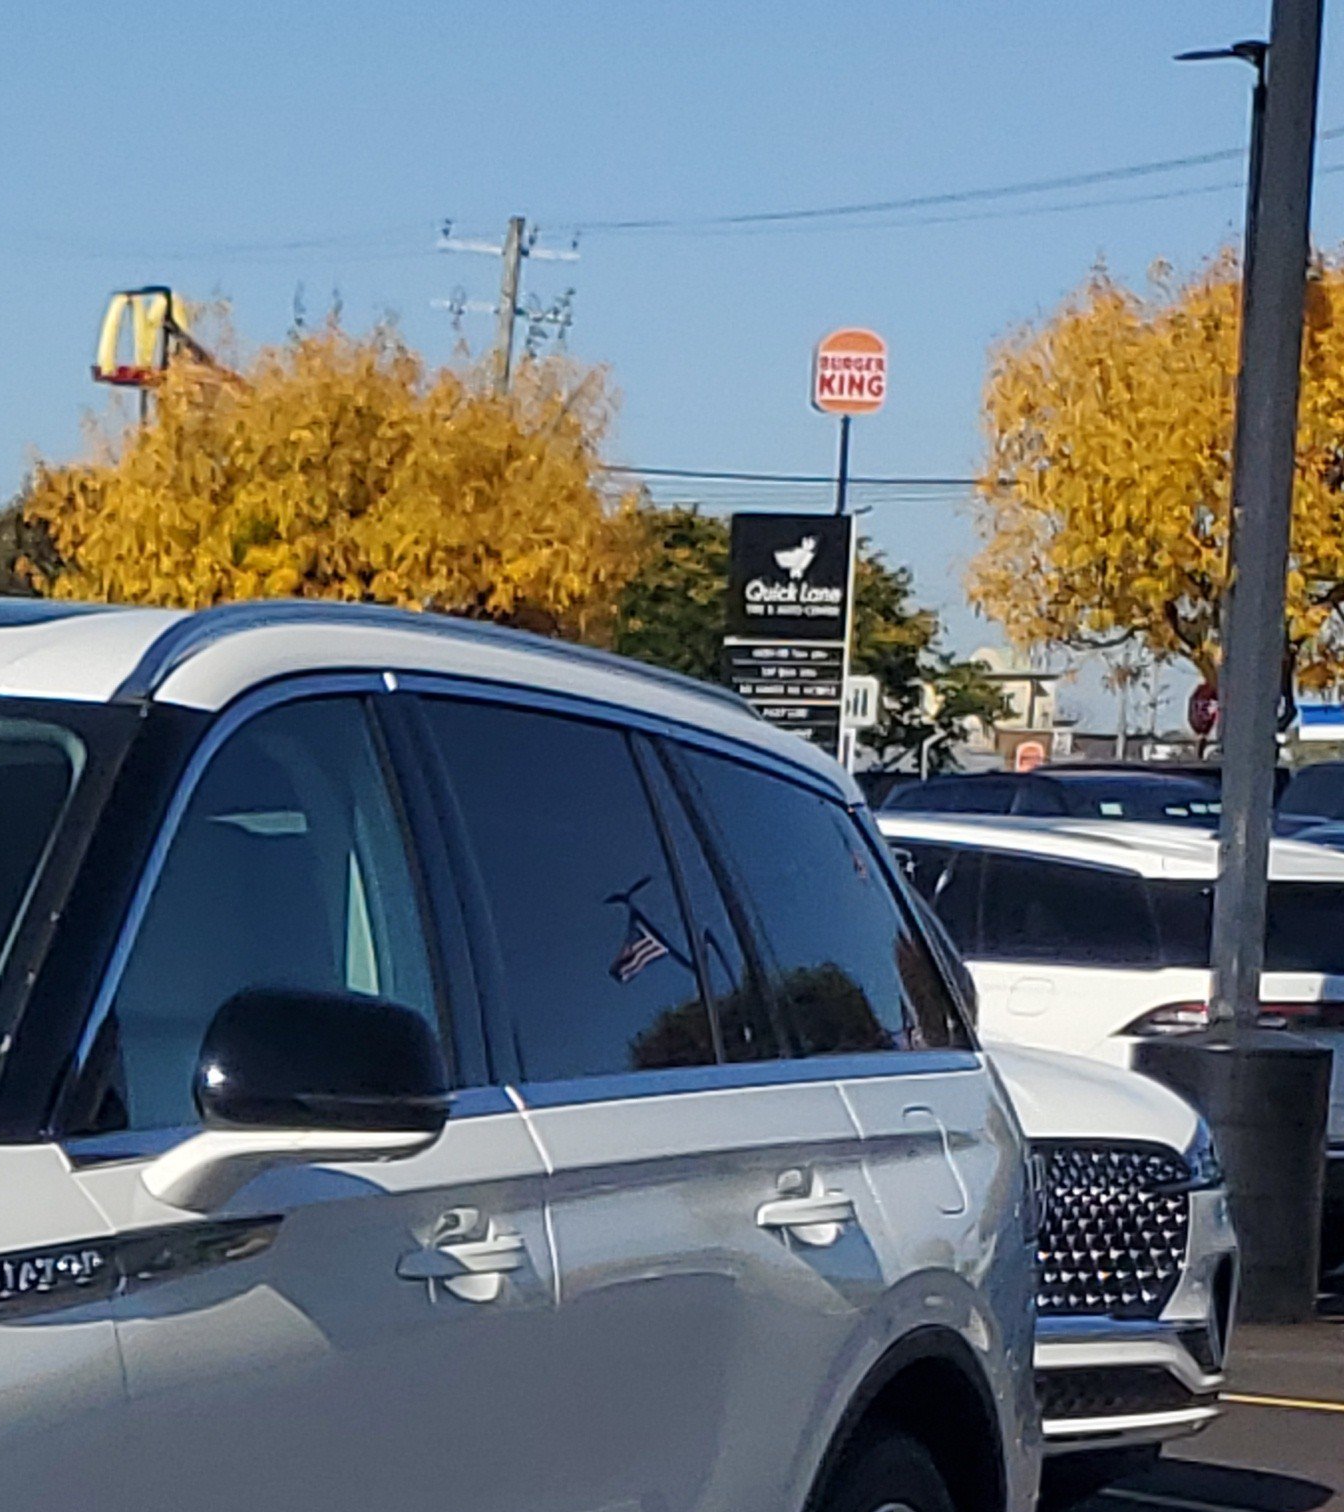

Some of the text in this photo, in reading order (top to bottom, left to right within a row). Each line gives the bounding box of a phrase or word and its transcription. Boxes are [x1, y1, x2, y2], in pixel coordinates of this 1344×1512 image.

[819, 373, 884, 397] KING
[745, 579, 842, 603] Quick Lane
